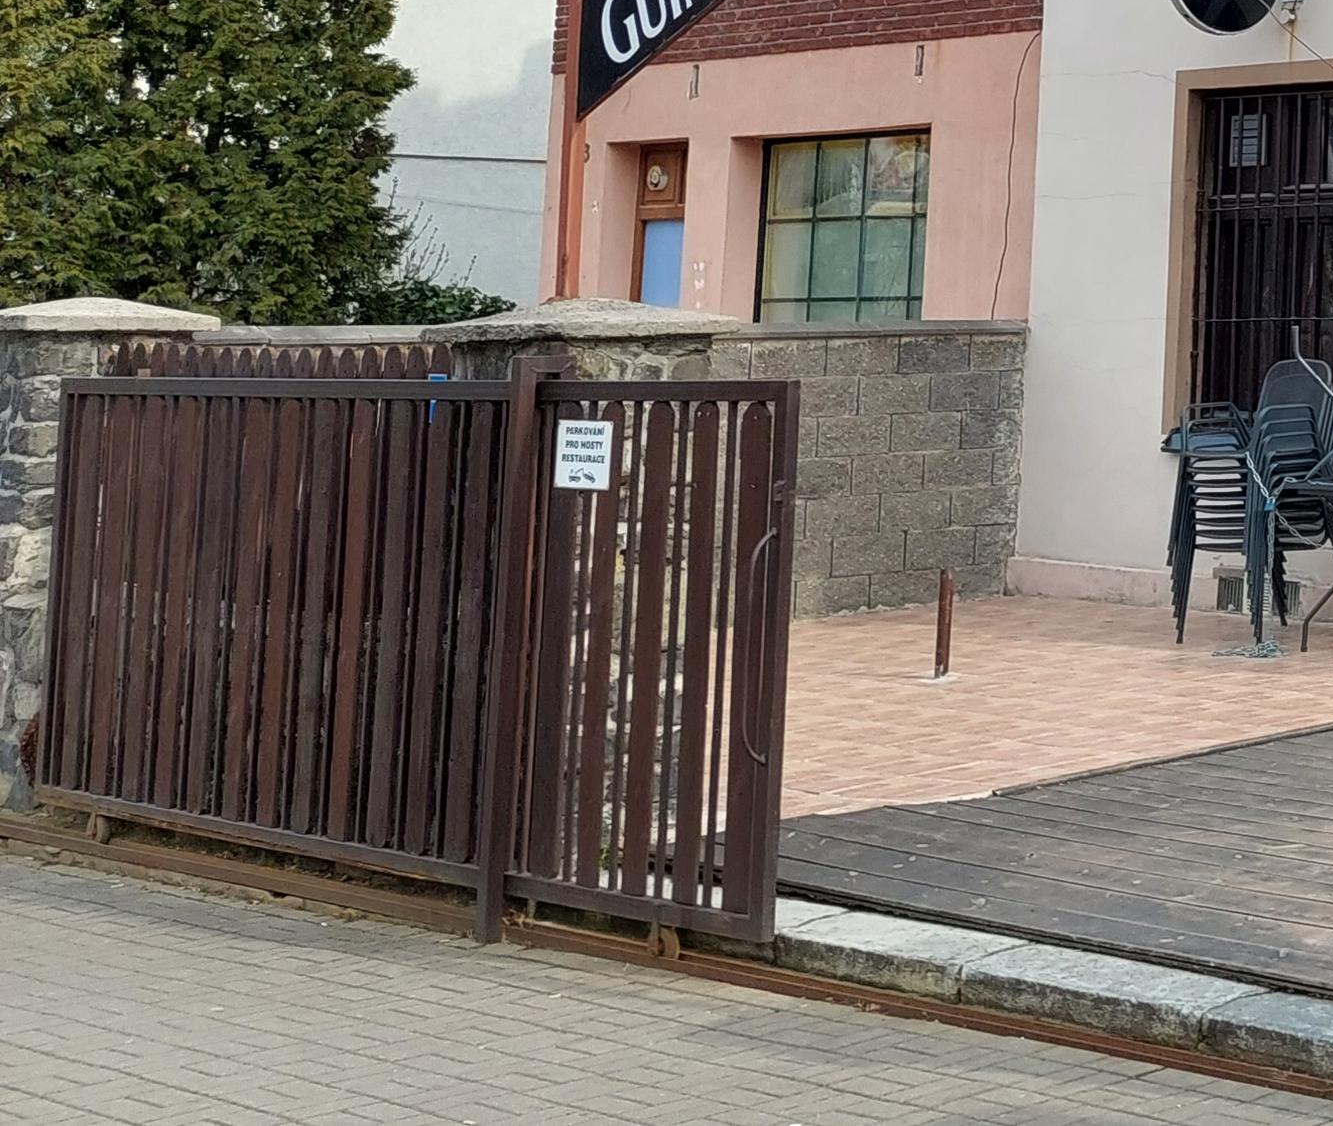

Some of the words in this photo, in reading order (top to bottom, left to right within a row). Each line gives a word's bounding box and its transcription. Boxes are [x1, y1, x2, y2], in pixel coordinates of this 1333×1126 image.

[565, 440, 579, 449] PRO
[580, 441, 604, 450] HOSTY
[561, 454, 606, 464] RESTAURACE
